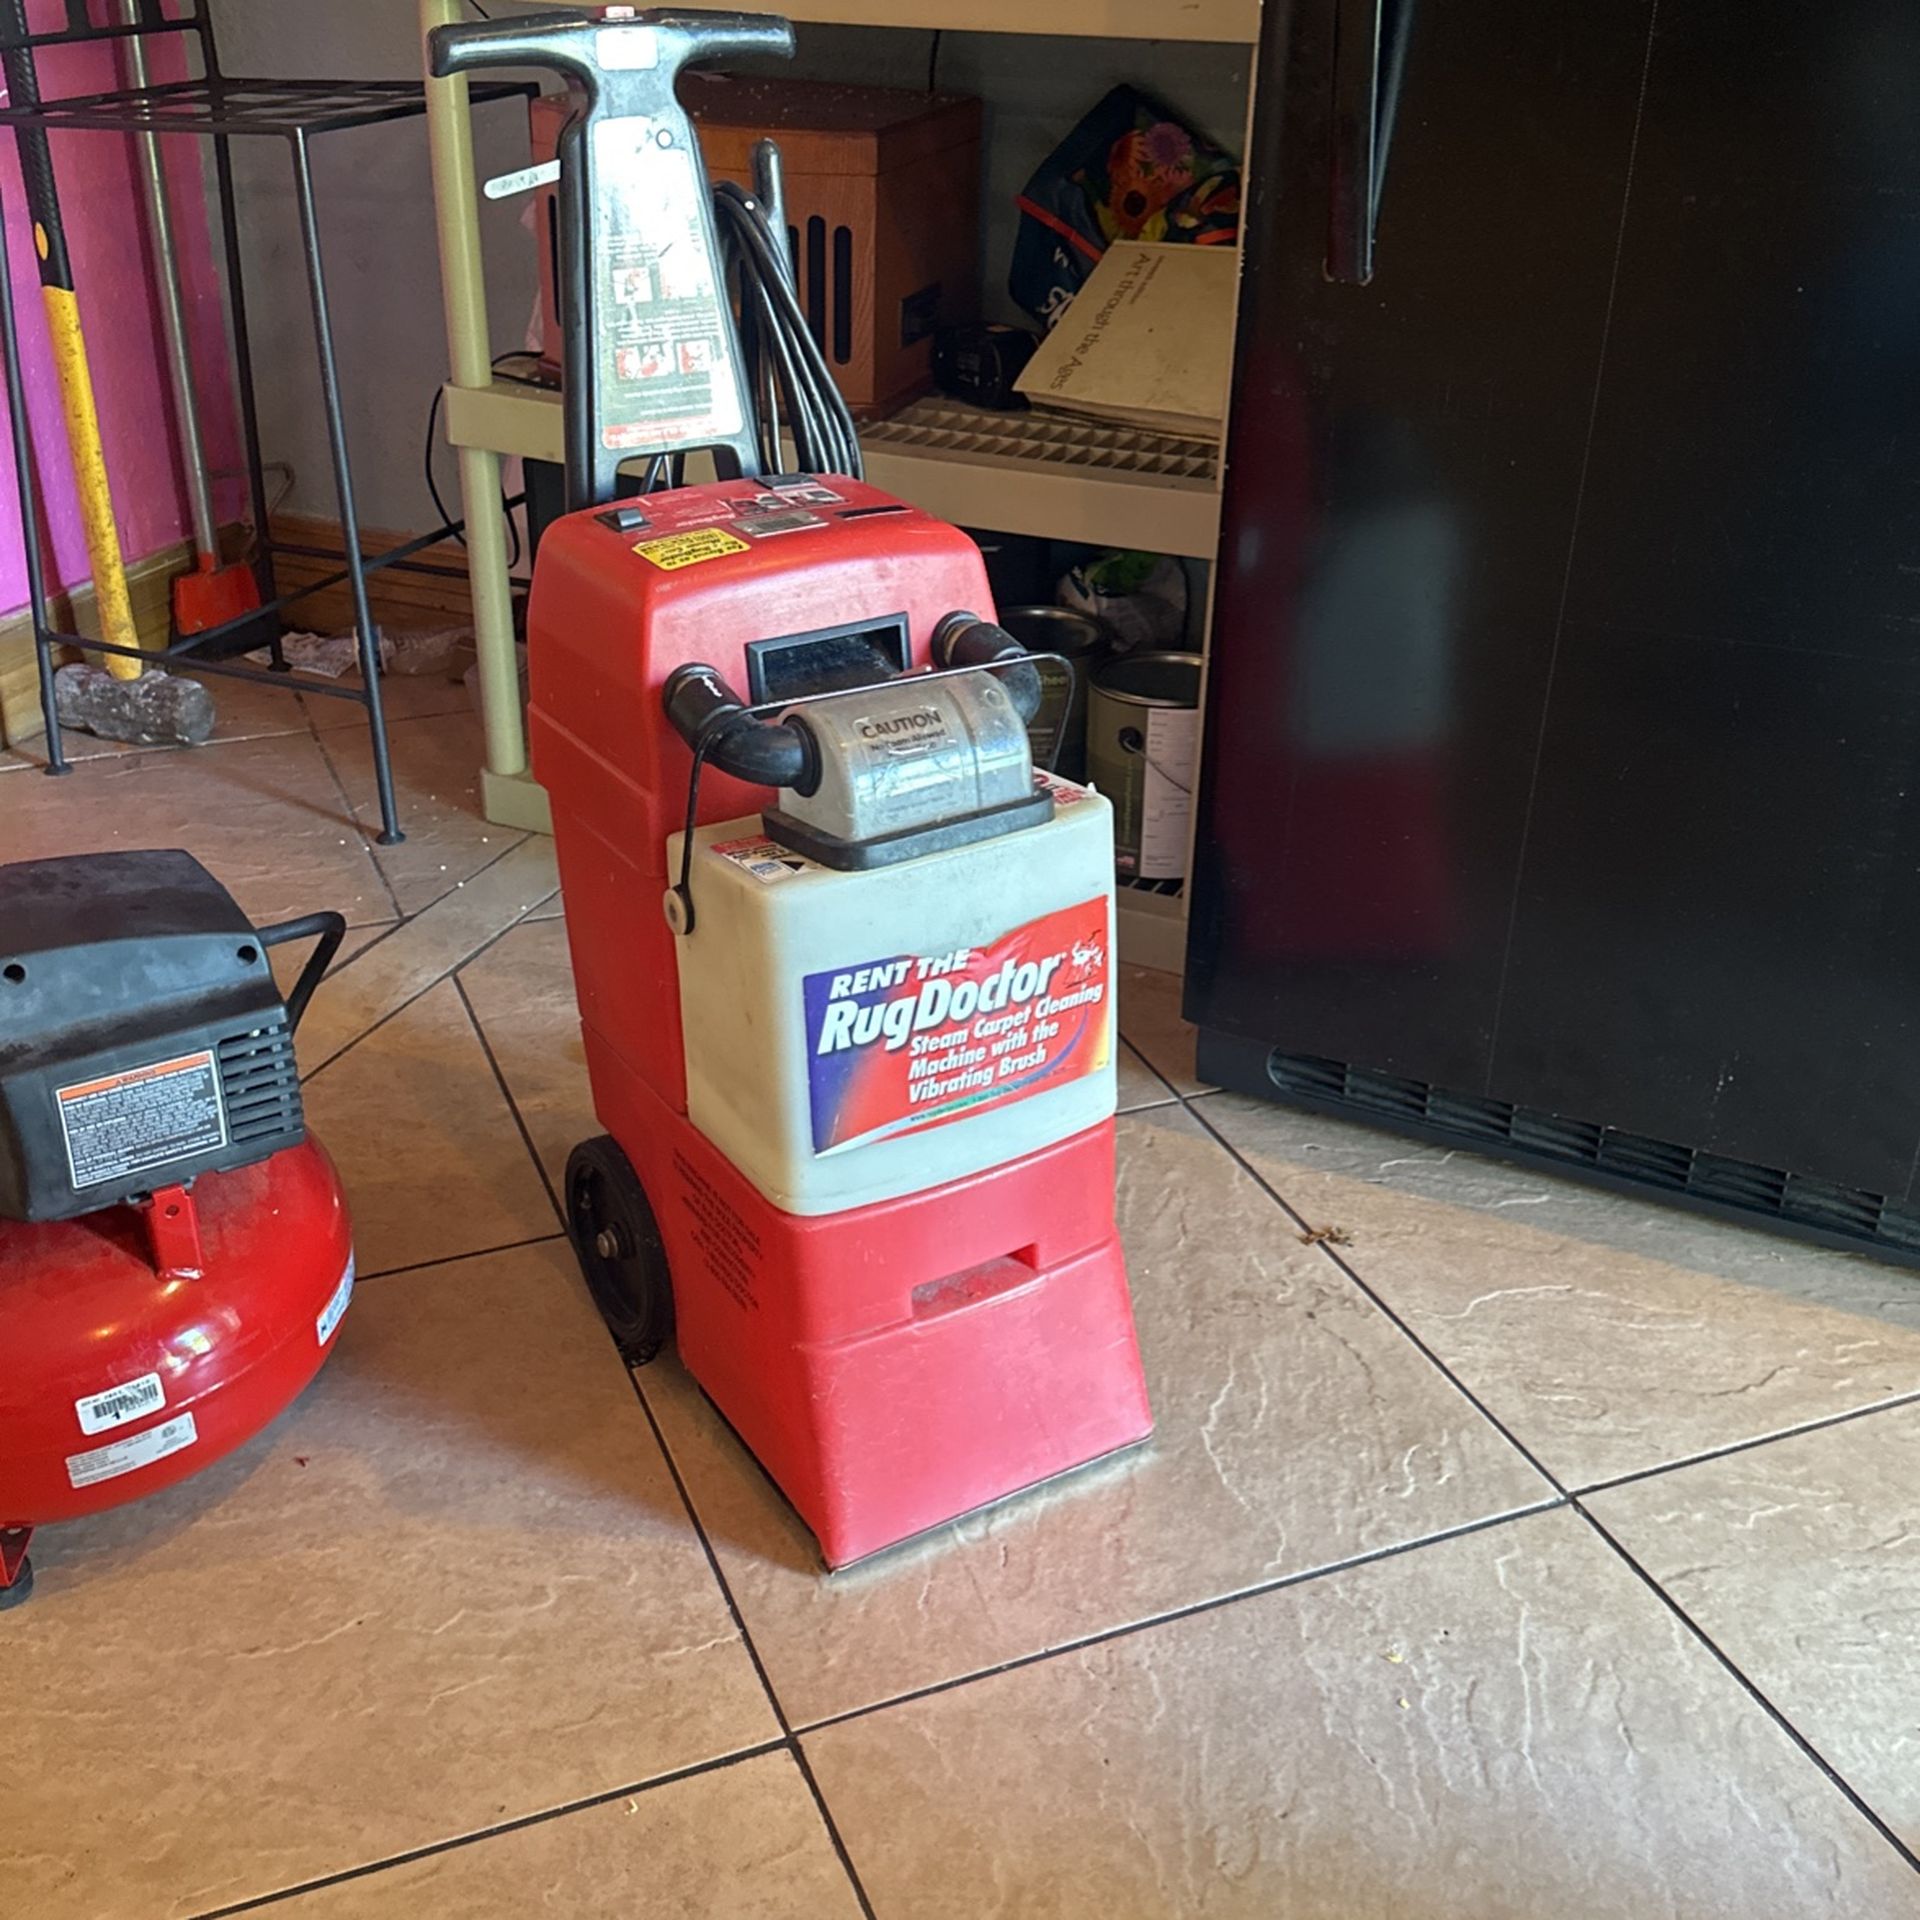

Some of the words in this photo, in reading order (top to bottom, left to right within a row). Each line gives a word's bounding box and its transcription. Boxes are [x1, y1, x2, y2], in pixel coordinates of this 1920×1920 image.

[1125, 252, 1152, 278] Art
[1092, 279, 1135, 330] through
[1075, 331, 1100, 355] the
[1050, 356, 1084, 391] Ages
[861, 710, 942, 739] CAUTION
[829, 961, 912, 1000] RENT
[916, 948, 973, 981] THE
[817, 955, 1064, 1055] RugDoctor
[908, 1022, 969, 1057] Steam
[973, 1007, 1031, 1043] Carpet
[1034, 983, 1104, 1019] Cleaning
[908, 1043, 985, 1081] Machine
[990, 1030, 1027, 1056] with
[1031, 1020, 1059, 1044] the
[909, 1064, 994, 1104] Vibrating
[999, 1044, 1046, 1077] Brush
